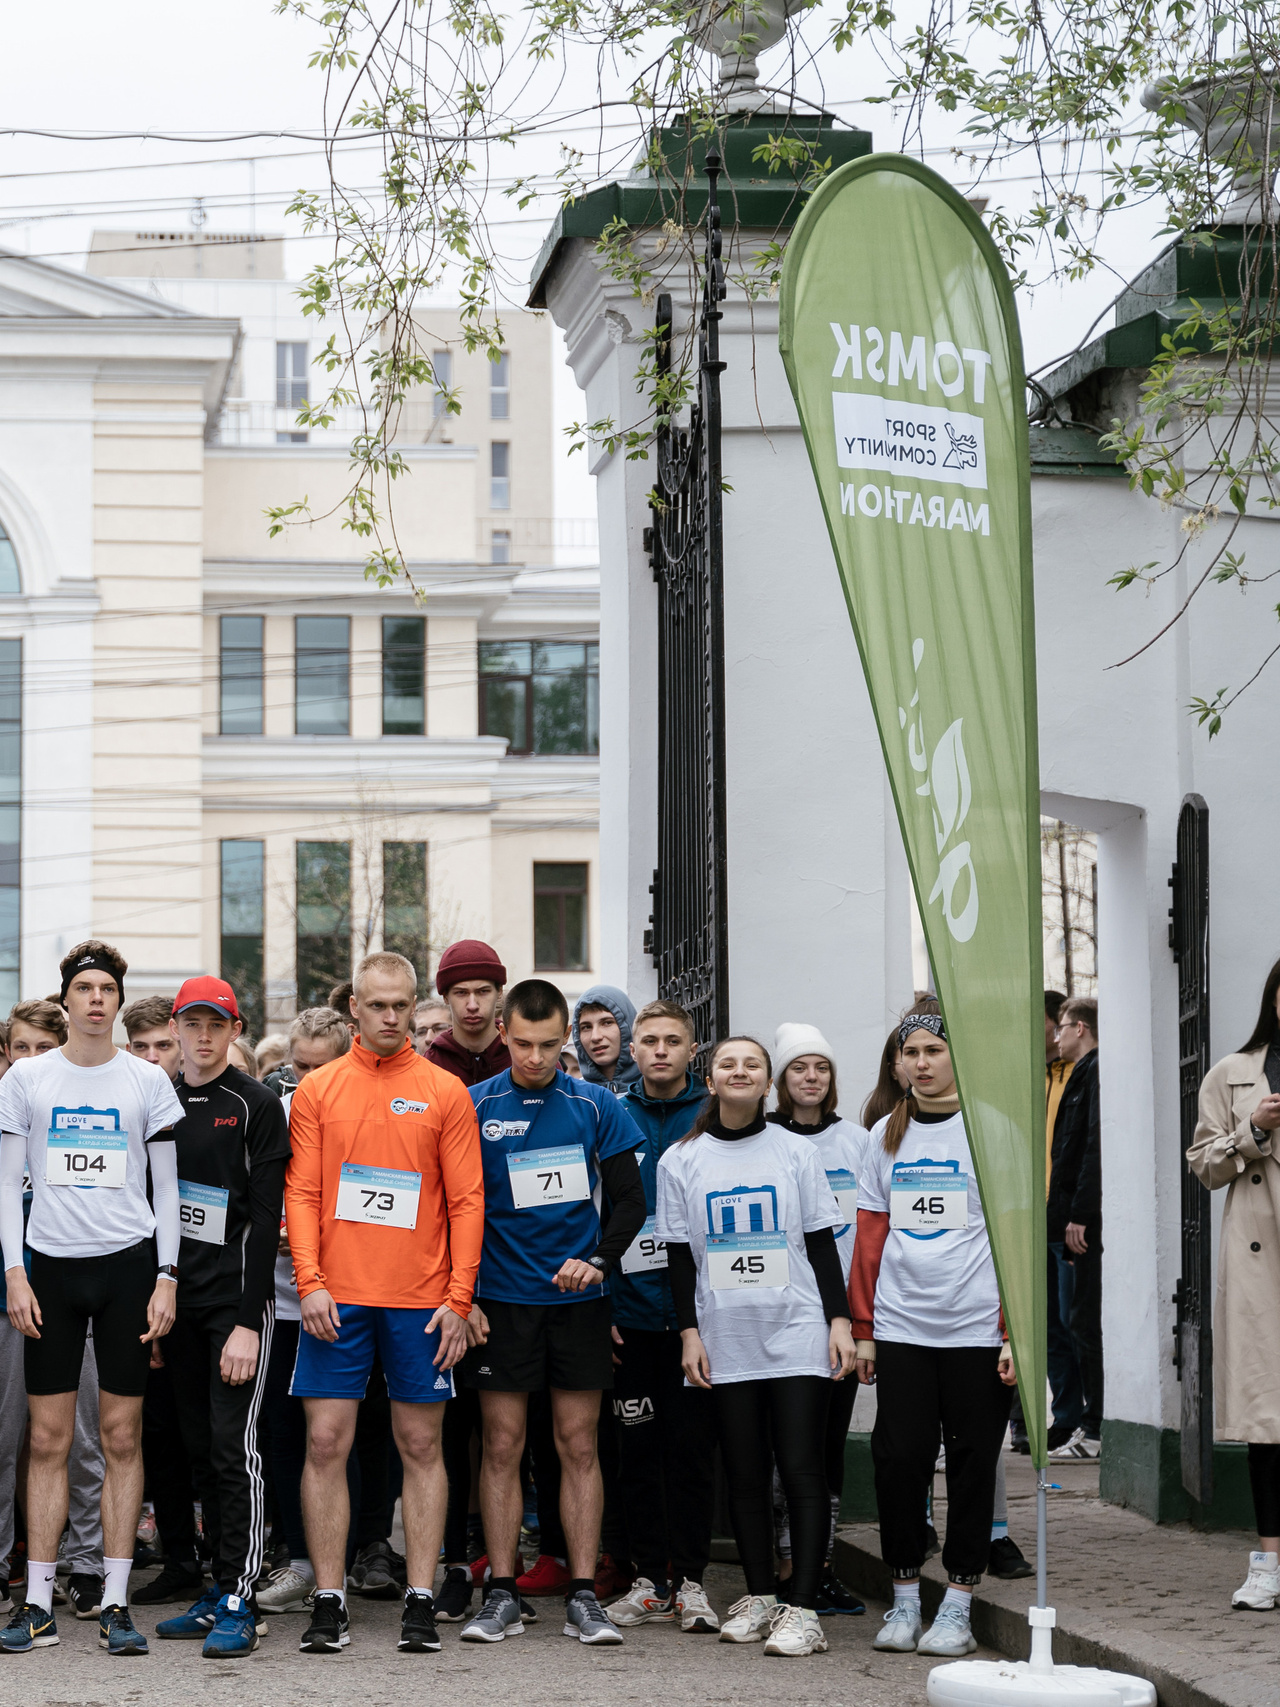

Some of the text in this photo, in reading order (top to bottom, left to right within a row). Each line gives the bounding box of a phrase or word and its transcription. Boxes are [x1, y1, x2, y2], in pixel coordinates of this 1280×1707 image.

[64, 1153, 107, 1173] 104
[537, 1171, 563, 1191] 71
[360, 1189, 395, 1211] 73
[720, 1197, 742, 1205] LOVE
[912, 1197, 945, 1215] 46
[179, 1204, 206, 1226] 69
[730, 1255, 765, 1274] 45
